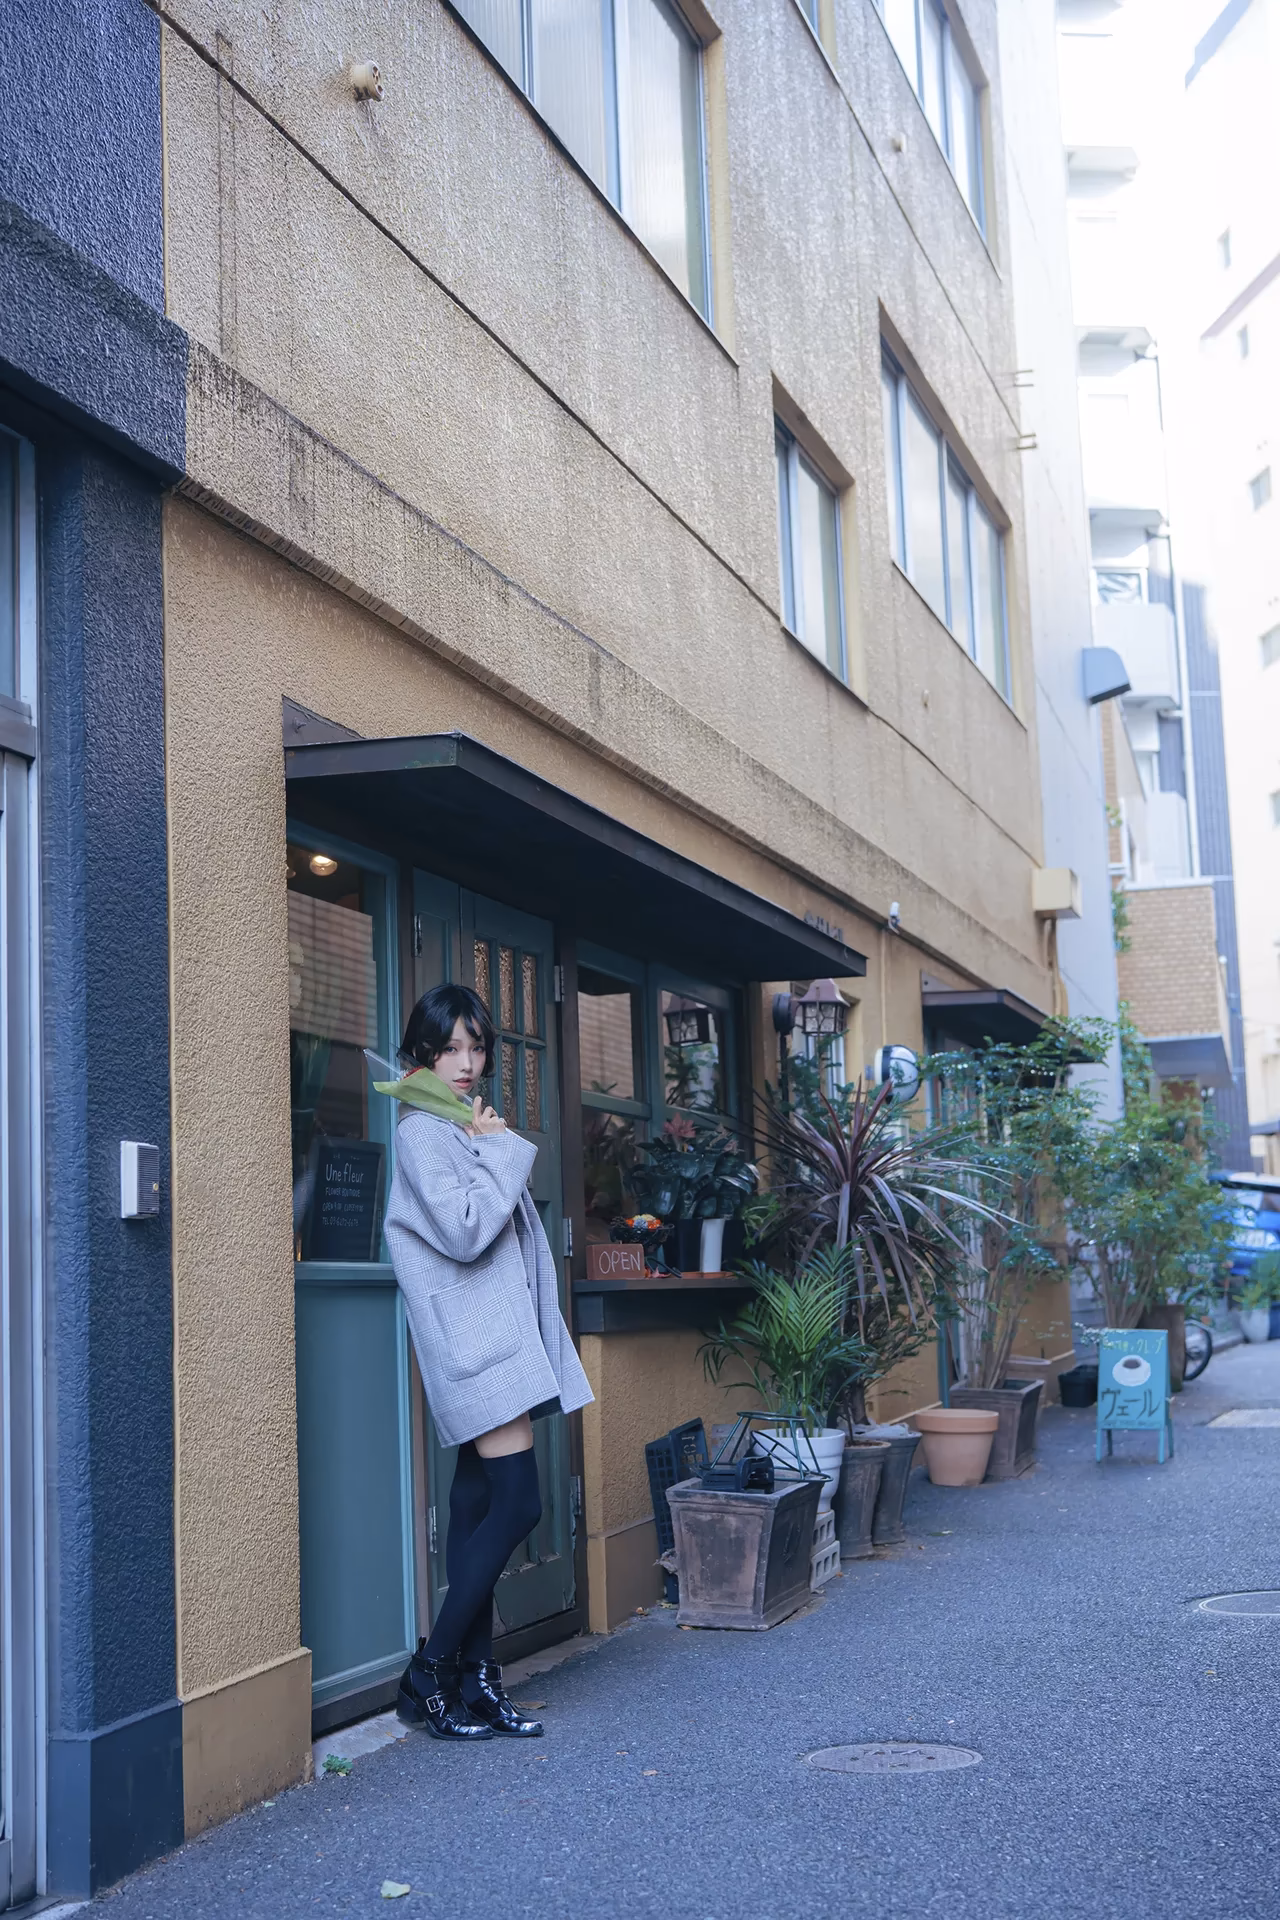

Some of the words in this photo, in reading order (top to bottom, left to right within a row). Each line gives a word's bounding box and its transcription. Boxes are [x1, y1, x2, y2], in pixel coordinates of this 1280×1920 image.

[325, 1163, 342, 1182] Une
[343, 1162, 364, 1183] fleur
[599, 1250, 641, 1275] OPEN
